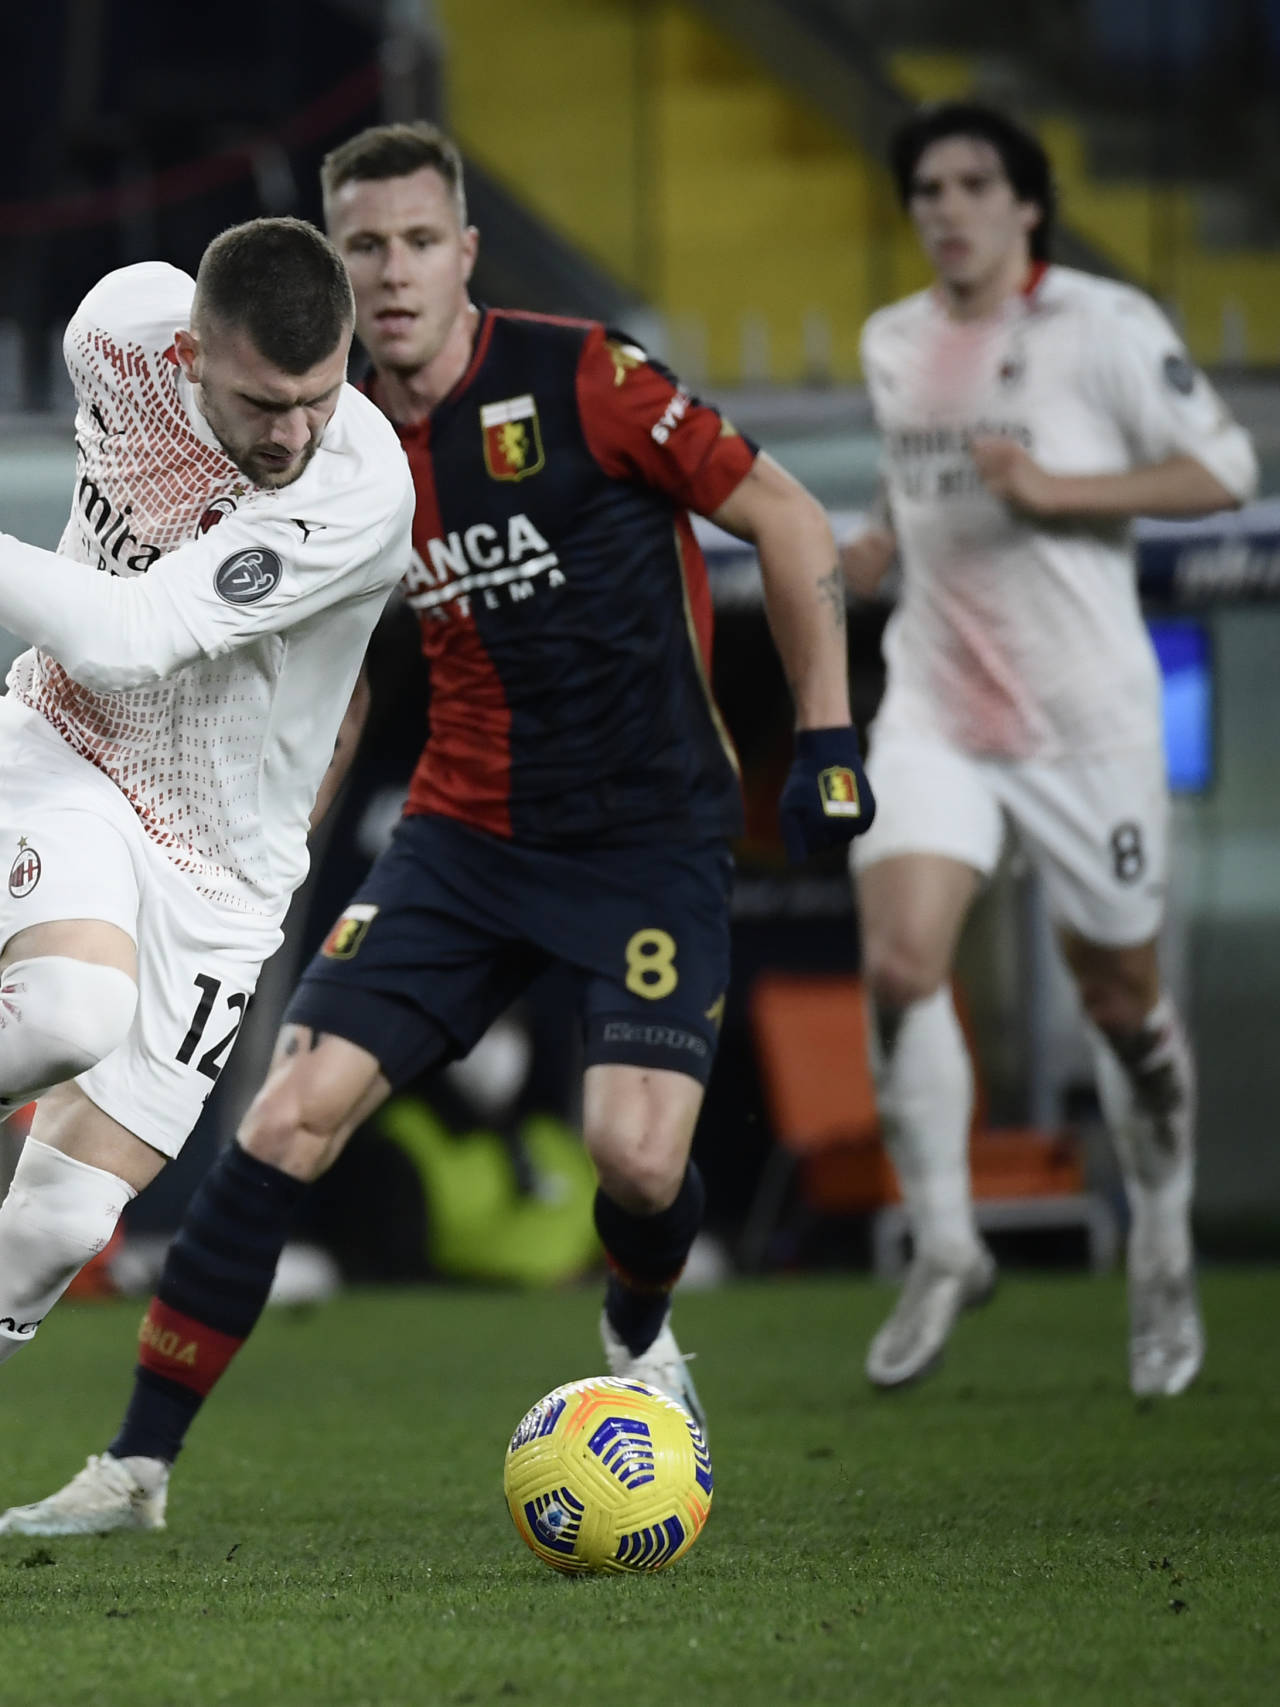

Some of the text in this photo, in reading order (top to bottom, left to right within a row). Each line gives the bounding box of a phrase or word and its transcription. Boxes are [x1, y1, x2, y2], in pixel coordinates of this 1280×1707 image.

[78, 474, 161, 574] mira
[404, 513, 549, 593] ANCA
[1110, 821, 1145, 886] 8
[625, 928, 678, 1000] 8
[175, 973, 246, 1082] 12
